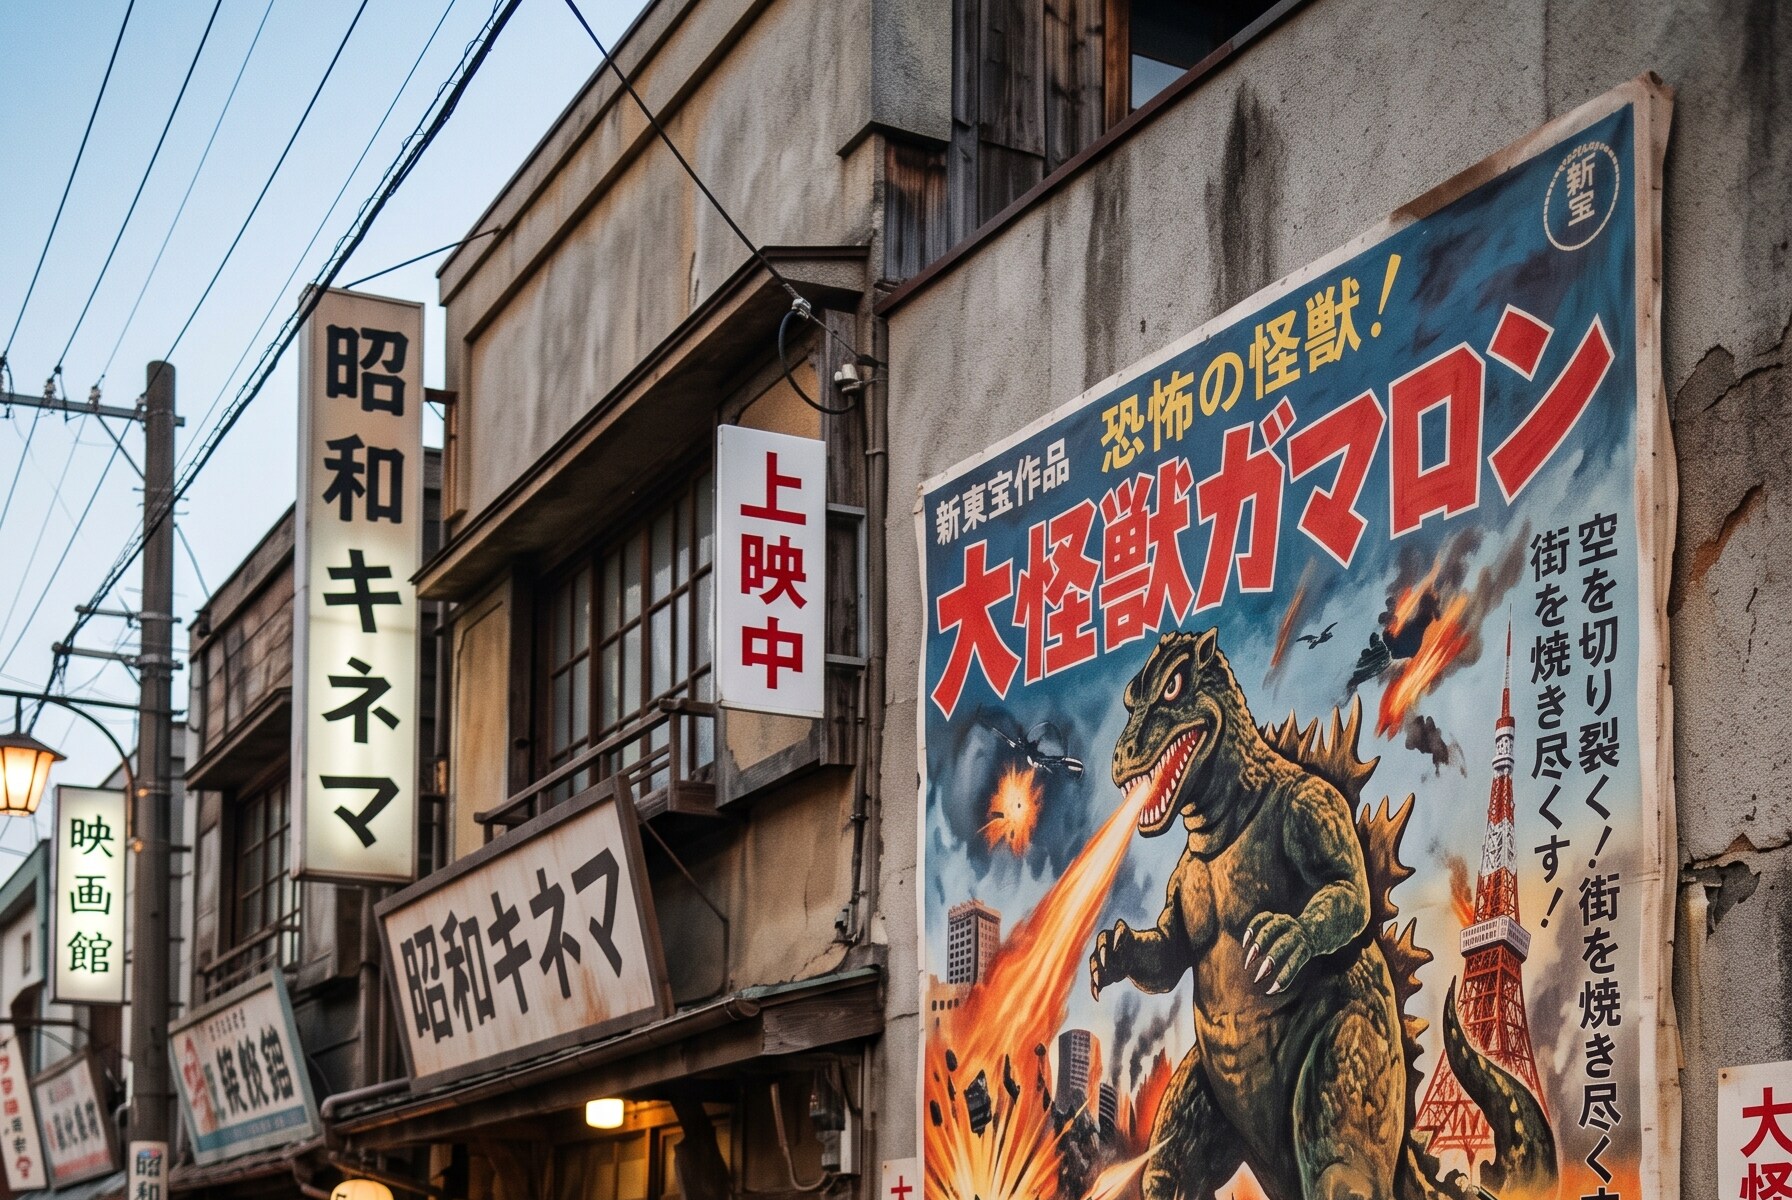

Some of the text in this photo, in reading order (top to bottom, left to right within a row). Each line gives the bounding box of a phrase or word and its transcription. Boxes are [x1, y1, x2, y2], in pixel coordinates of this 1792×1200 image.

[1100, 253, 1402, 473] 恐怖の怪獣！
[320, 323, 409, 848] 昭和キネマ
[740, 451, 808, 689] 上映中
[931, 303, 1616, 721] 大怪獣ガマロン
[935, 438, 1070, 546] 新東宝作品
[1530, 526, 1573, 928] 街を焼き尽くす！
[67, 814, 115, 974] 映画館
[400, 847, 623, 1044] 昭和キネマ
